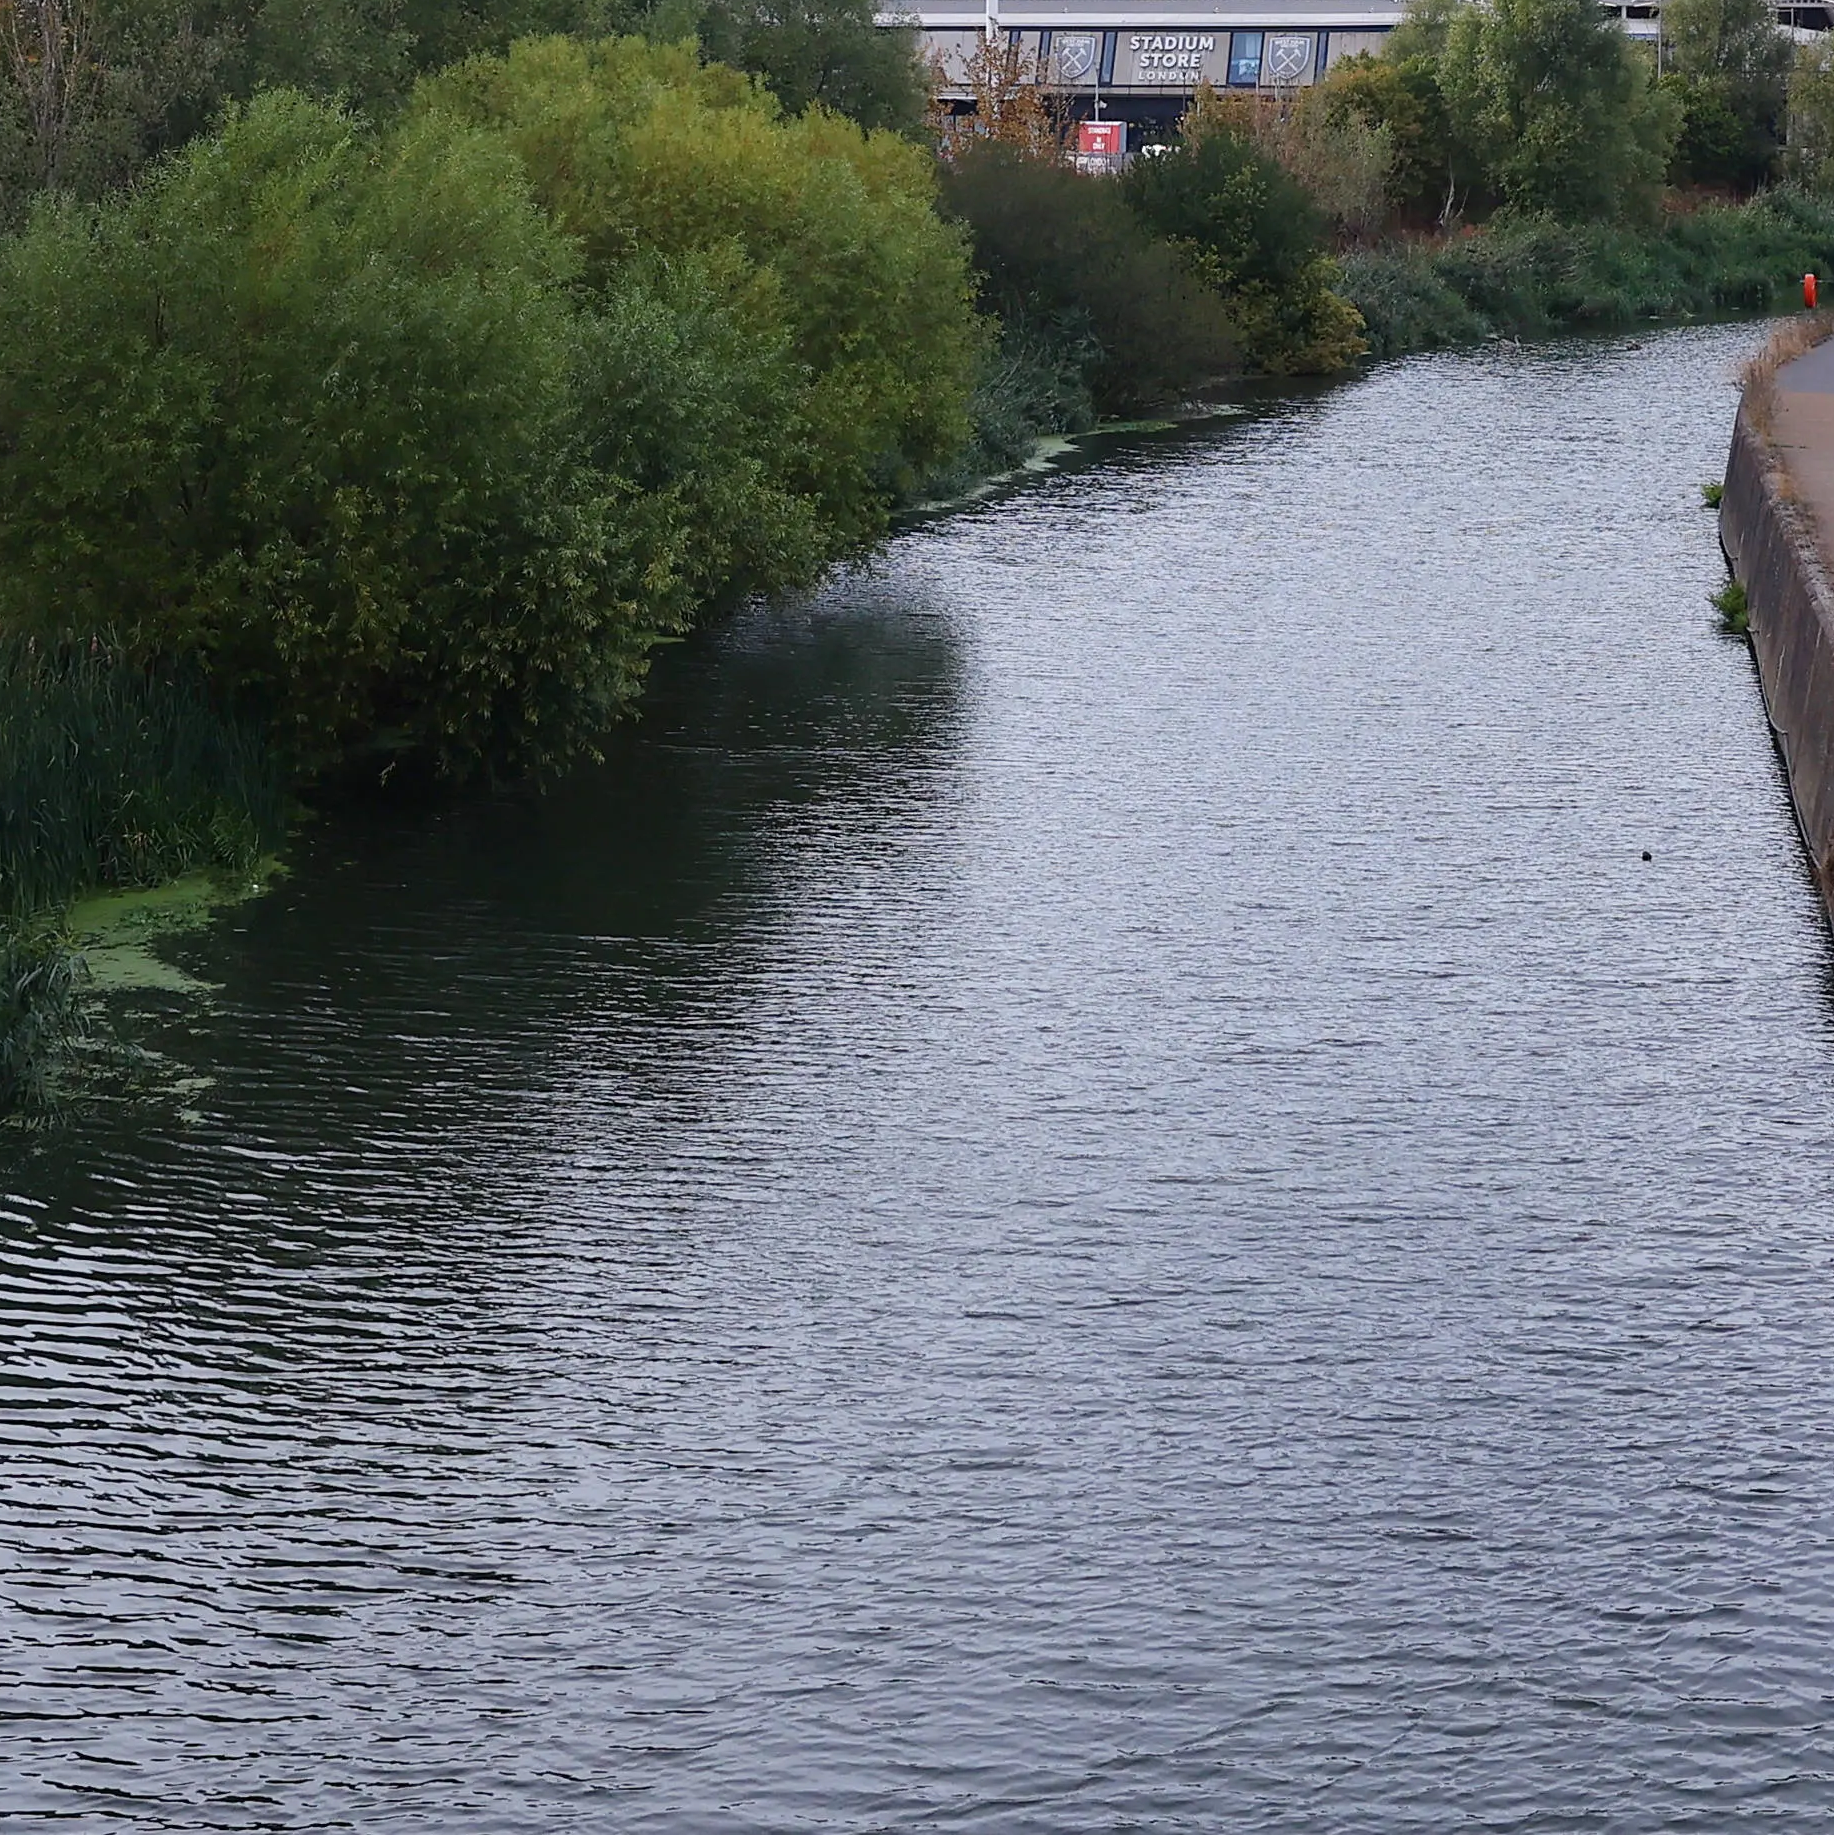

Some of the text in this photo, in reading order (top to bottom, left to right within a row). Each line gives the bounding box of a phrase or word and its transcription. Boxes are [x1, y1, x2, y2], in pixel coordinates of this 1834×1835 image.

[1130, 36, 1214, 51] STADIUM
[1139, 53, 1201, 68] STORE
[1138, 70, 1200, 81] LONDON
